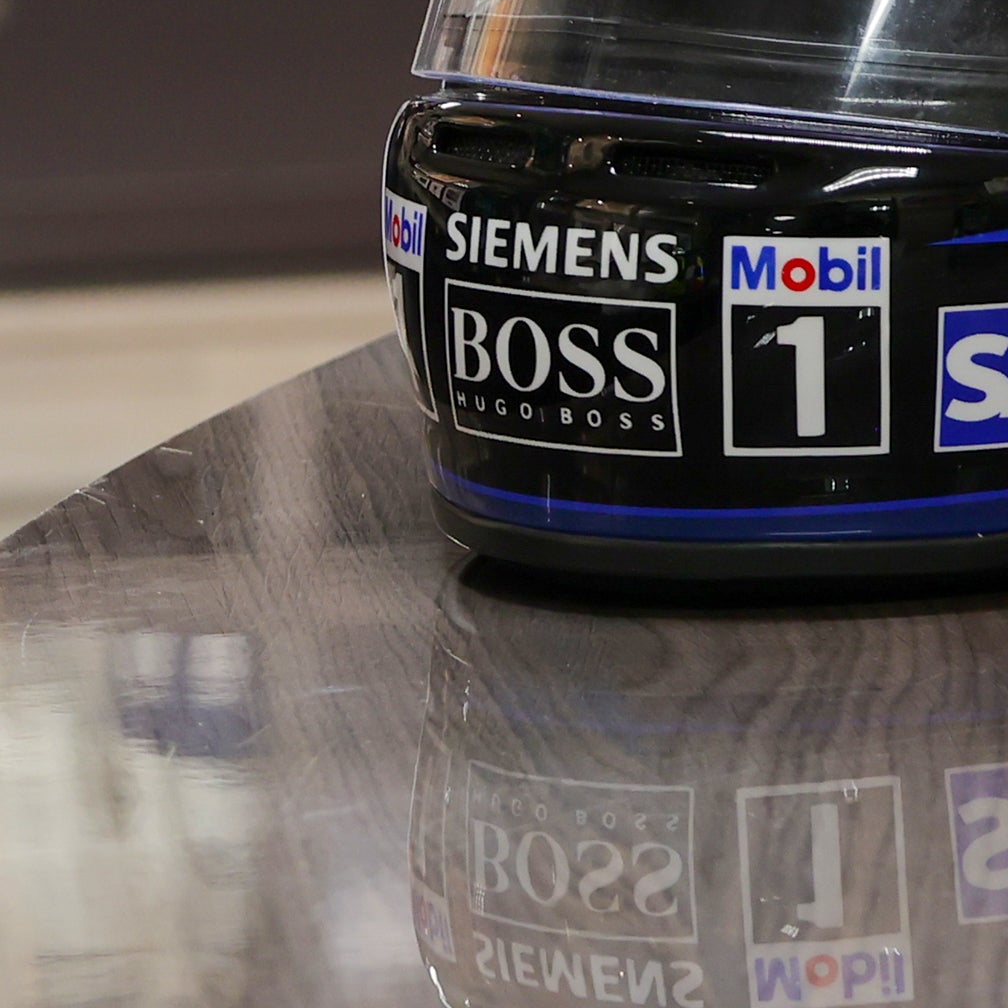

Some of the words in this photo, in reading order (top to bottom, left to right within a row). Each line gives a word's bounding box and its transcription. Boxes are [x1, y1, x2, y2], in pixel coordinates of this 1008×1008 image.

[445, 212, 679, 284] SIEMENS
[731, 245, 881, 292] Mobil
[451, 307, 666, 403] BOSS
[776, 315, 826, 437] 1
[456, 391, 533, 420] HUGO
[560, 407, 665, 431] BOSS
